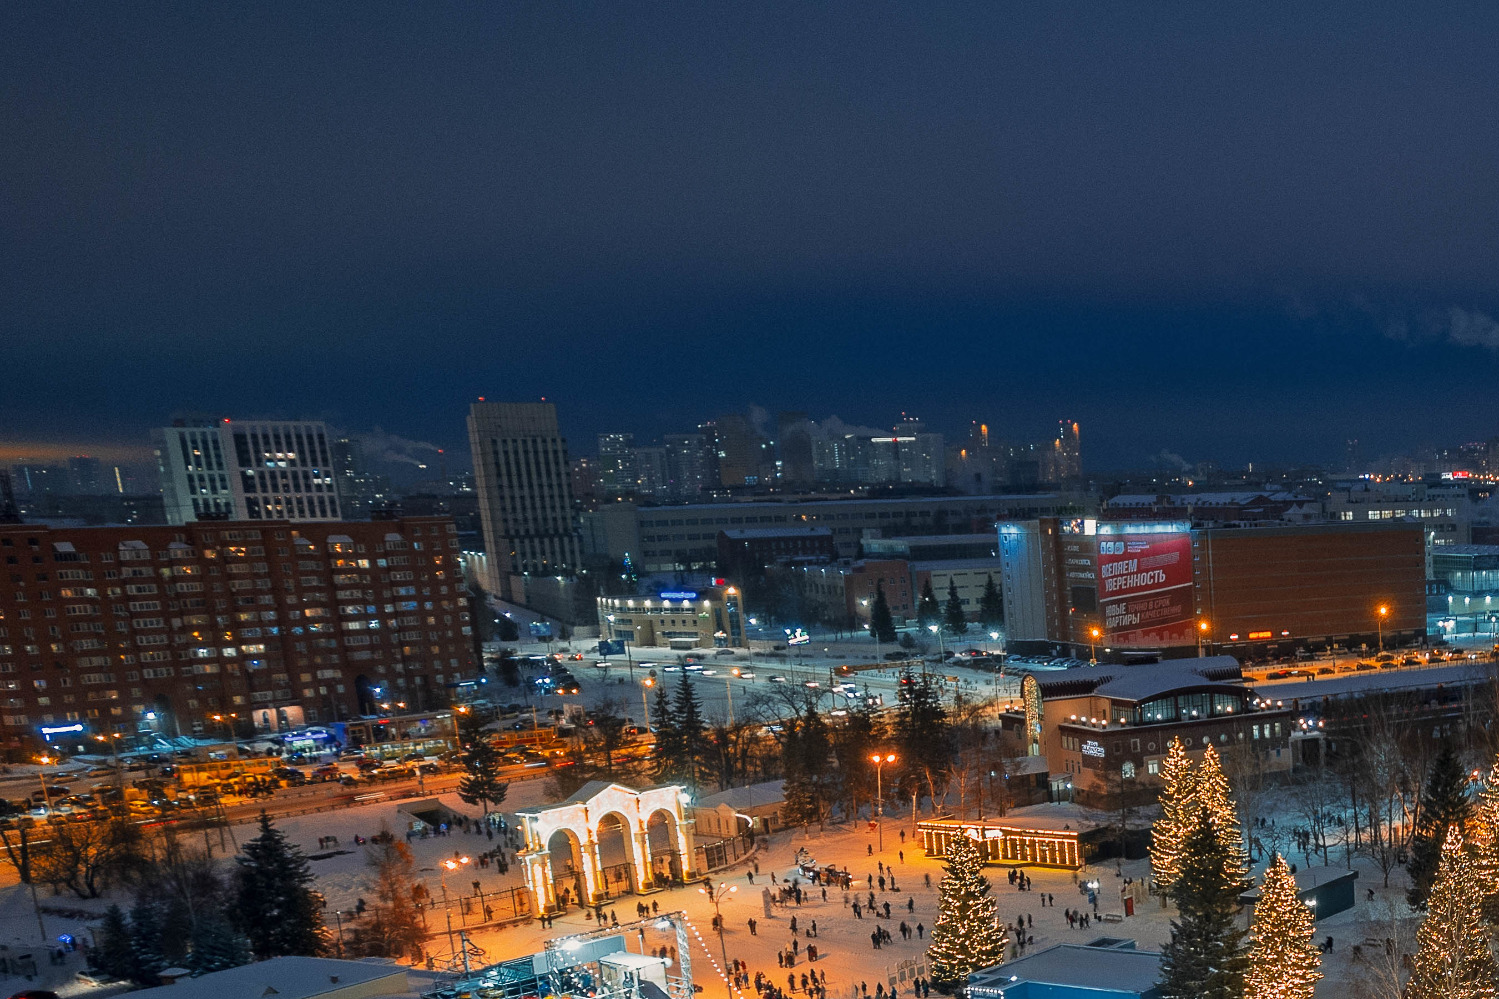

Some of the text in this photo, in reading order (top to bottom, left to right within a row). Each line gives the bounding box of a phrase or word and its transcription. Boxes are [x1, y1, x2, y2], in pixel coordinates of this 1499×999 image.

[1101, 558, 1138, 578] ВСЕЛЯЕМ
[1105, 569, 1166, 592] УВЕРЕННОСТЬ
[1105, 602, 1127, 617] НОВЫЕ
[1105, 612, 1140, 628] КВАРТИРЫ
